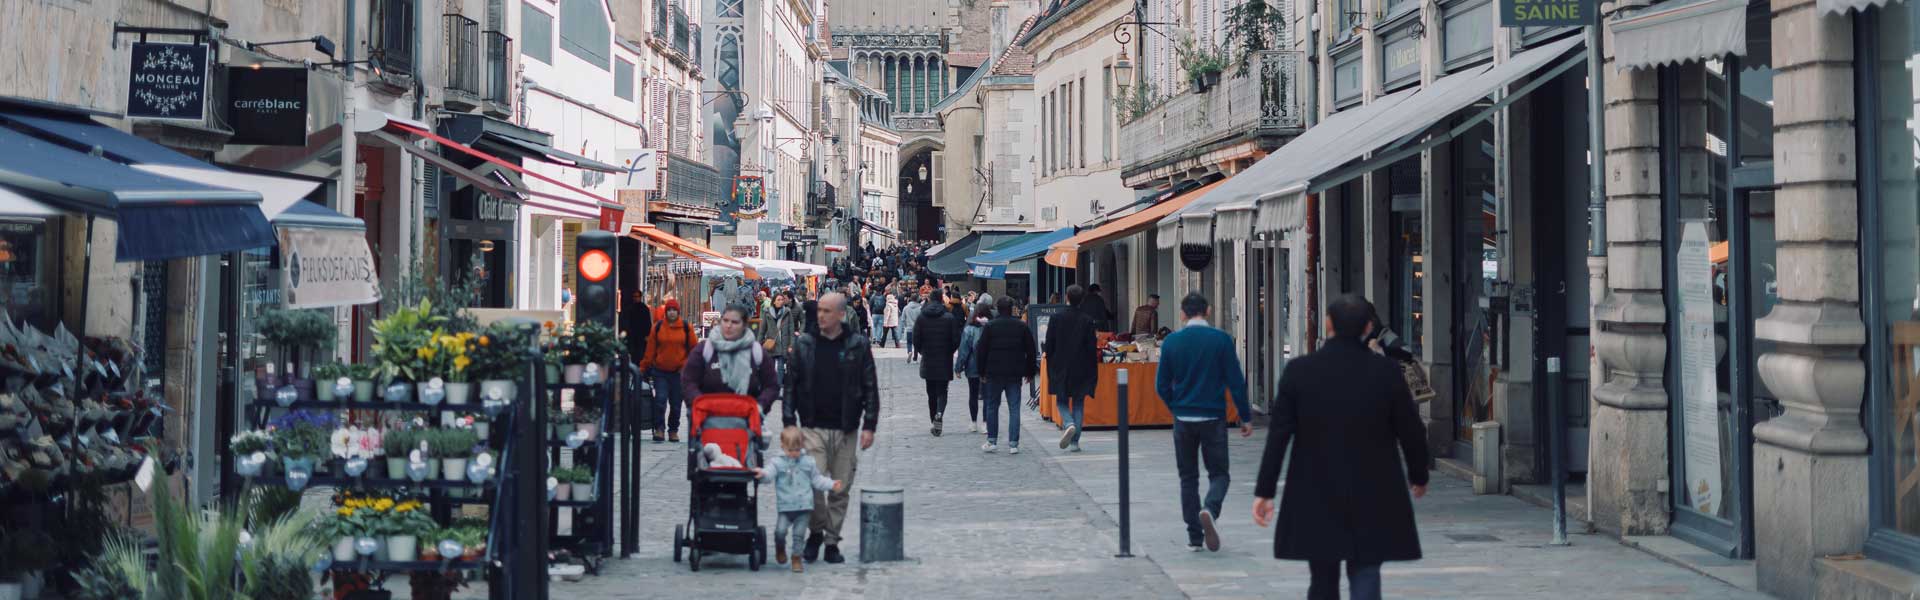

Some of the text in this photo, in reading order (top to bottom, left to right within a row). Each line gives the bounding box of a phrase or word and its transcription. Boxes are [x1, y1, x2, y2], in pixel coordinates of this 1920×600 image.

[1514, 4, 1580, 20] SAINE
[135, 73, 200, 85] MONCEAU
[234, 99, 301, 109] carréblanc
